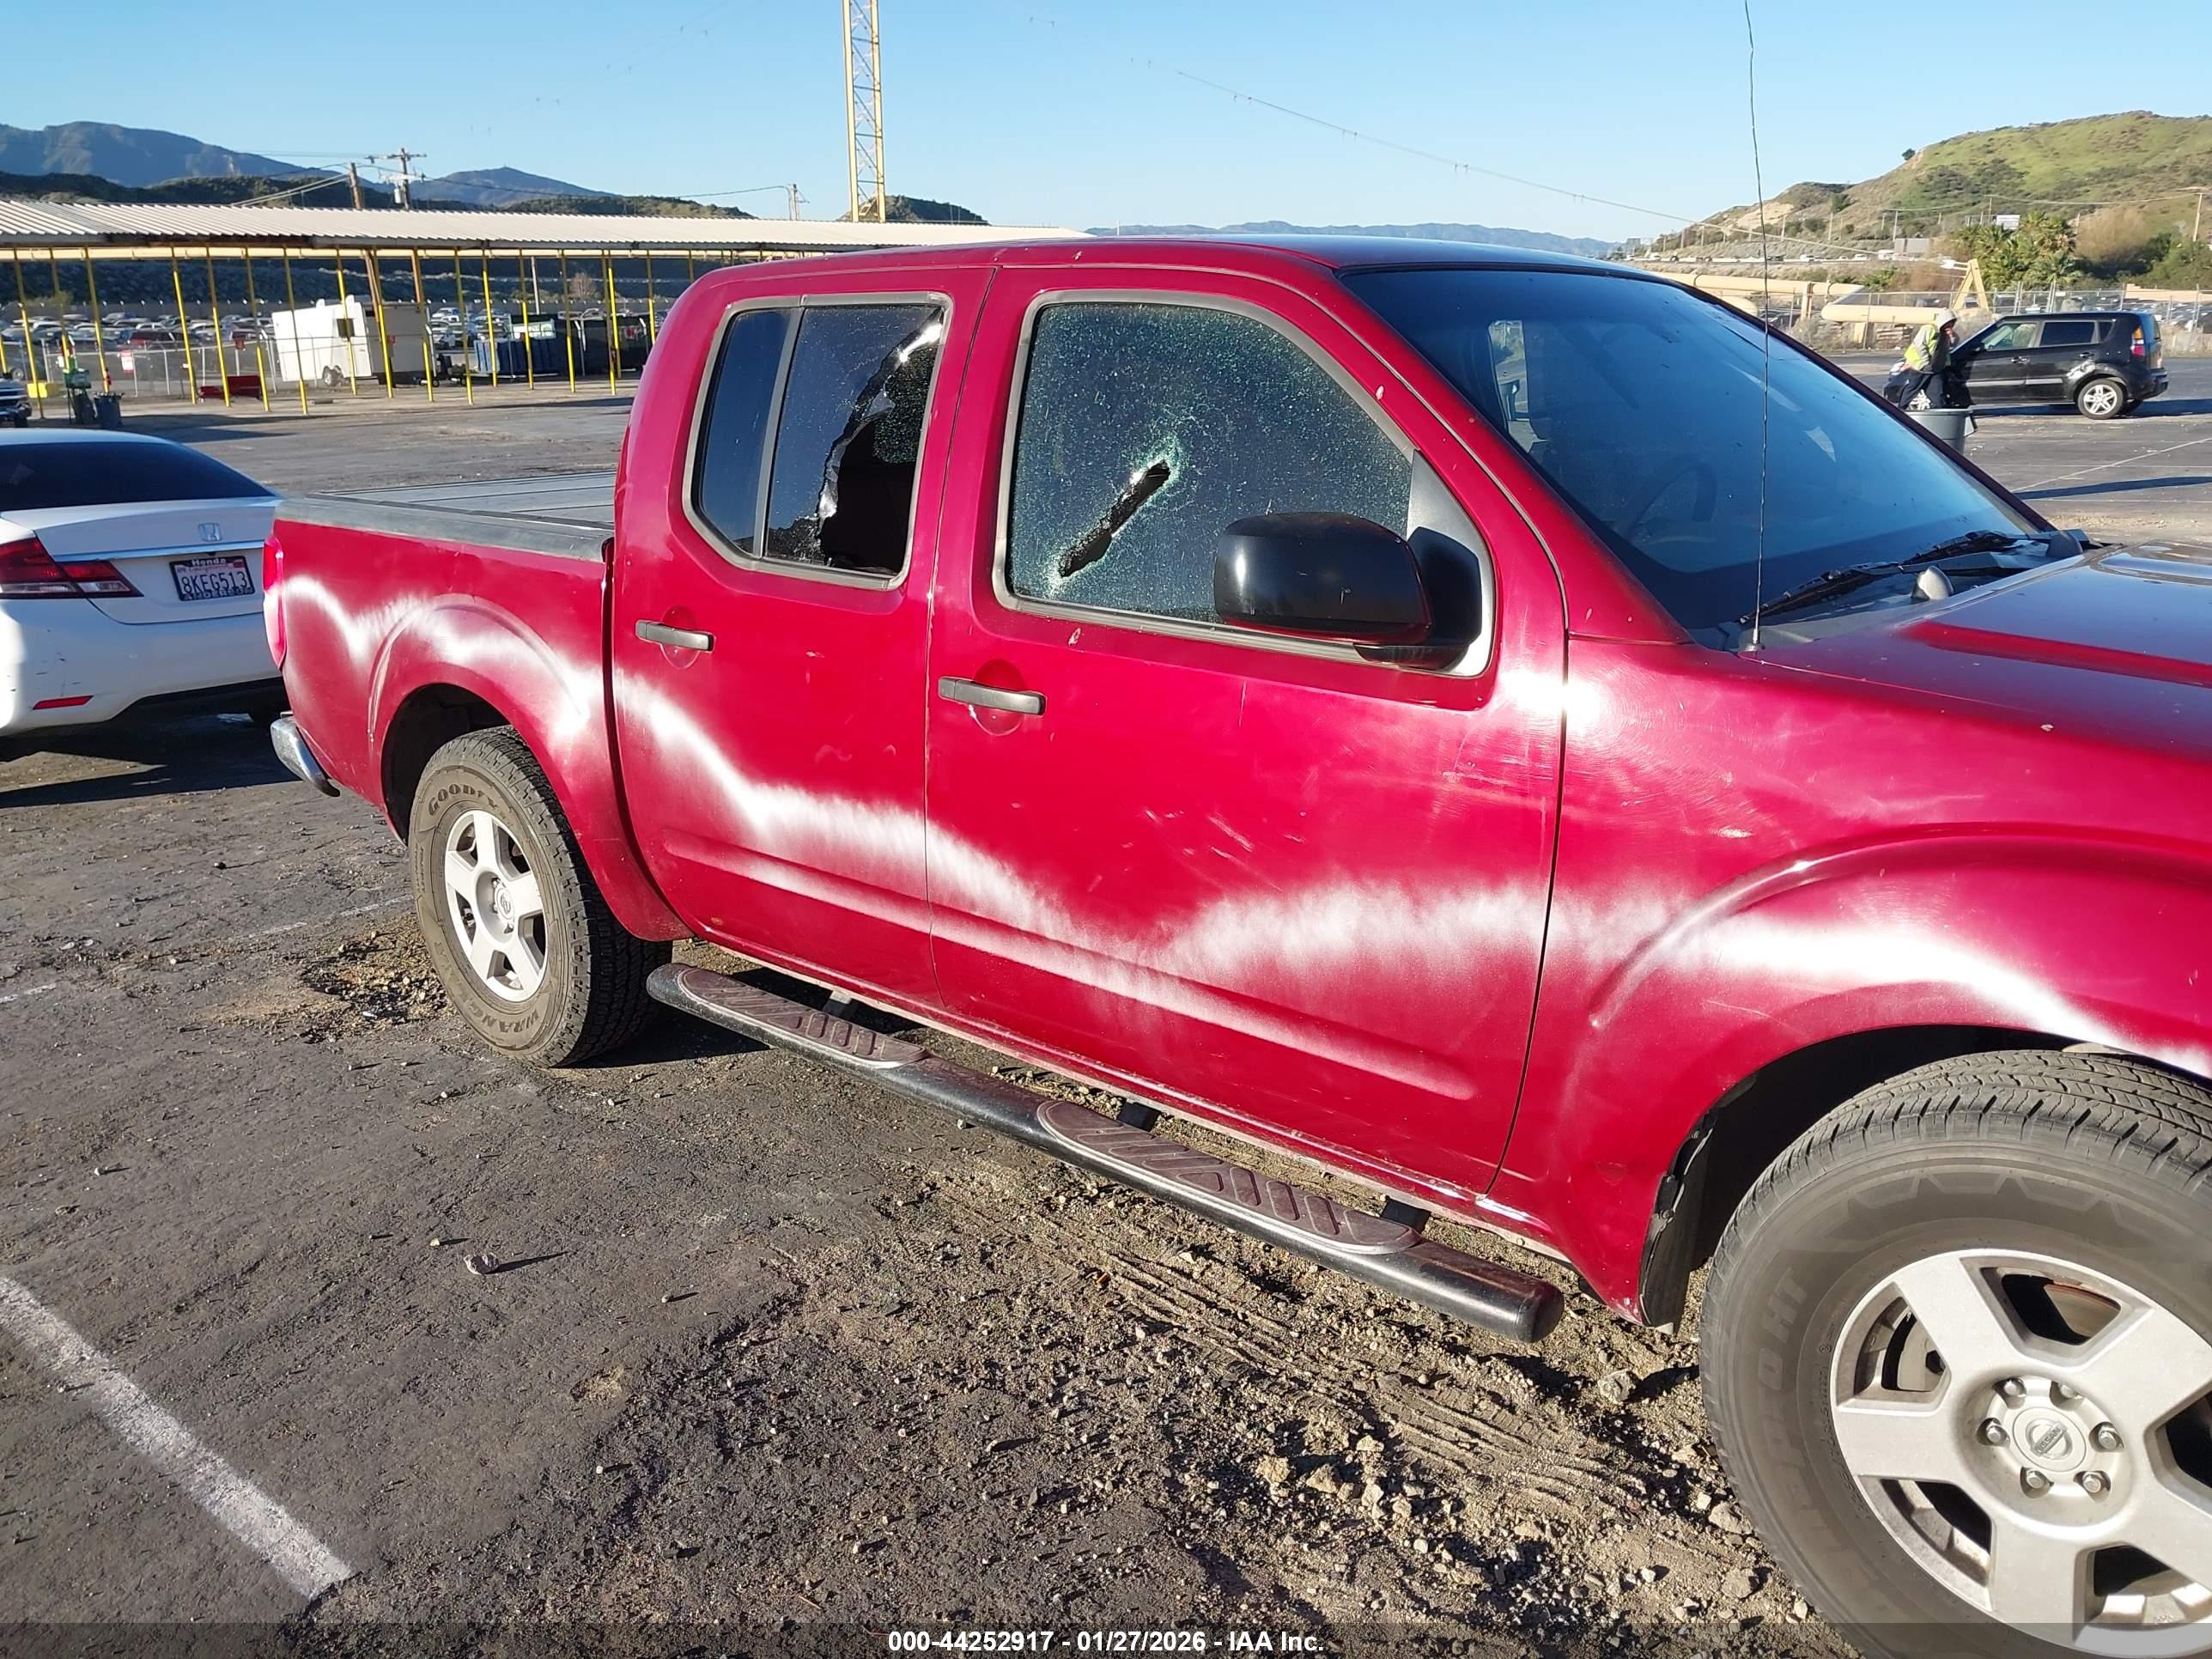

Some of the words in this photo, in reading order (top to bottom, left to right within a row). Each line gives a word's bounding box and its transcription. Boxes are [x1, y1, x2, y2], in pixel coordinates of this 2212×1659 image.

[191, 557, 227, 566] Honda
[181, 570, 248, 594] 8KEG513
[1758, 1267, 1808, 1342] HT
[2033, 1425, 2062, 1453] NISSAN
